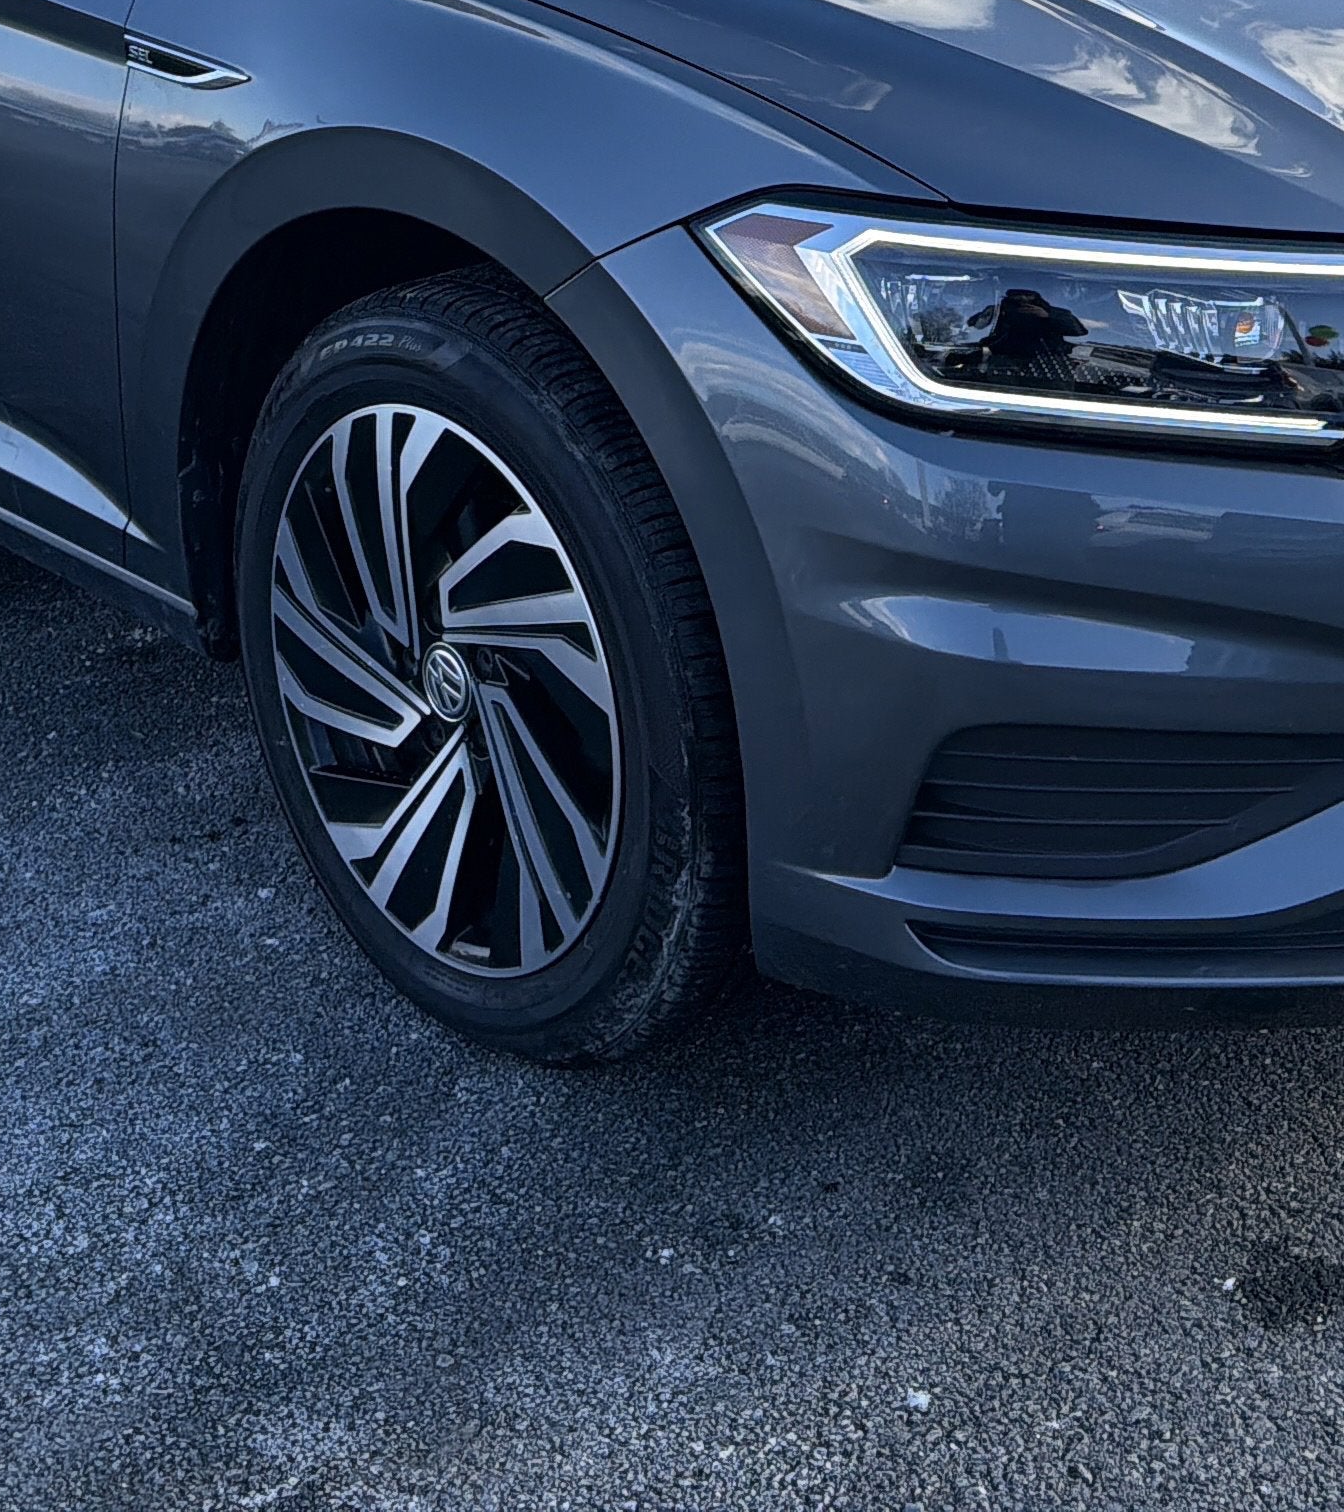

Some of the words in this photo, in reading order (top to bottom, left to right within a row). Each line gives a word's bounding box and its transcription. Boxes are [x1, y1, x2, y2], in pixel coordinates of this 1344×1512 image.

[128, 45, 154, 65] SEL
[347, 333, 395, 349] 422
[398, 335, 422, 352] Plus
